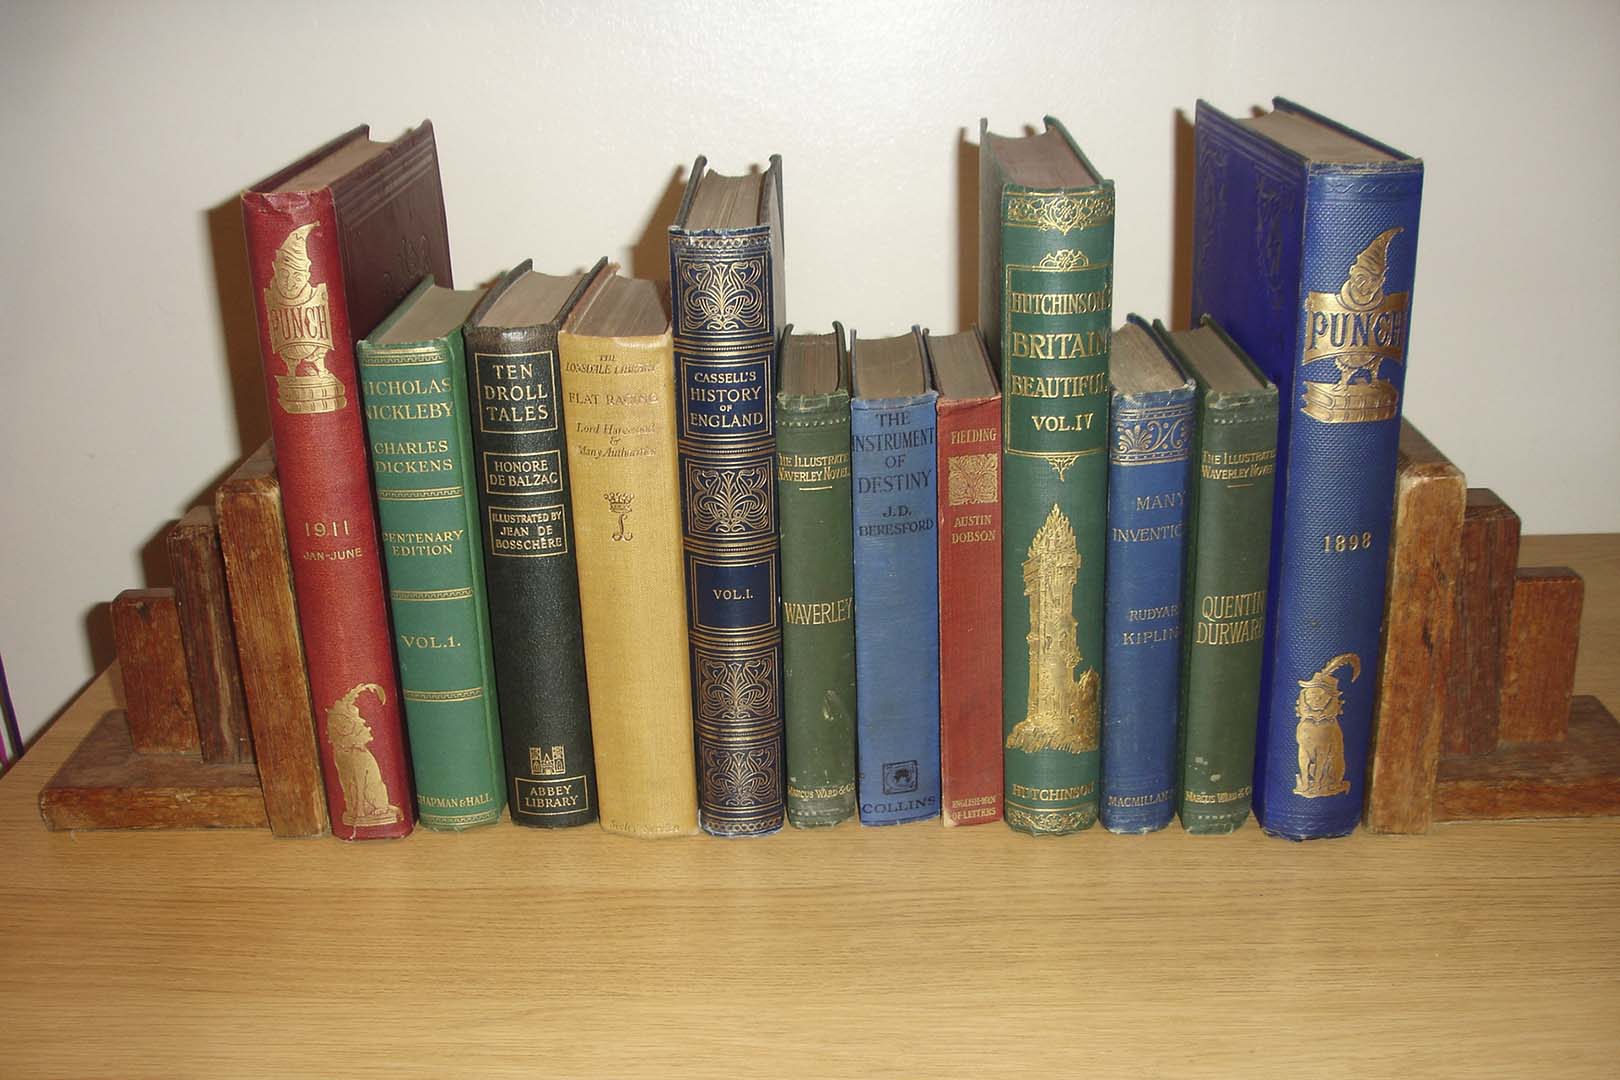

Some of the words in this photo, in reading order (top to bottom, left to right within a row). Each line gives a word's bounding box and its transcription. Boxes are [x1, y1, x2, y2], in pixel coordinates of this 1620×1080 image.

[271, 305, 329, 339] PUNCH
[1311, 311, 1401, 348] PUNCH
[492, 363, 533, 379] TEN
[694, 371, 757, 384] CASSELL'S
[484, 383, 548, 401] DROLL
[568, 392, 600, 405] FLAT
[690, 385, 761, 402] HISTORY
[486, 404, 549, 422] TALES
[719, 404, 732, 412] OF
[690, 412, 763, 428] ENGLAND
[876, 412, 911, 427] THE
[1032, 412, 1094, 432] VOL.IV
[576, 422, 600, 434] Lord
[951, 427, 997, 444] FIELDING
[374, 440, 449, 455] CHARLES
[610, 436, 621, 446] &
[376, 458, 453, 473] DICKENS
[494, 459, 549, 473] HONORE
[885, 454, 907, 469] OF
[489, 474, 506, 486] DE
[508, 471, 558, 488] BALZAC
[858, 470, 932, 494] DESTINY
[1136, 490, 1186, 511] MANY
[492, 512, 549, 524] ILLUSTRATED
[550, 511, 562, 521] BY
[882, 506, 912, 518] J.D.
[305, 520, 350, 537] 1911
[859, 519, 934, 537] BERESFORD
[954, 515, 992, 528] AUSTIN
[500, 526, 529, 537] JEAN
[537, 525, 553, 537] DE
[951, 530, 996, 544] DOBSON
[392, 543, 453, 557] EDITION
[1323, 532, 1372, 553] 1898
[303, 547, 363, 561] JAN-JUNE
[784, 597, 853, 625] WAVERLEY
[530, 784, 572, 796] ABBEY
[525, 795, 579, 808] LIBRARY
[862, 795, 936, 814] COLLINS
